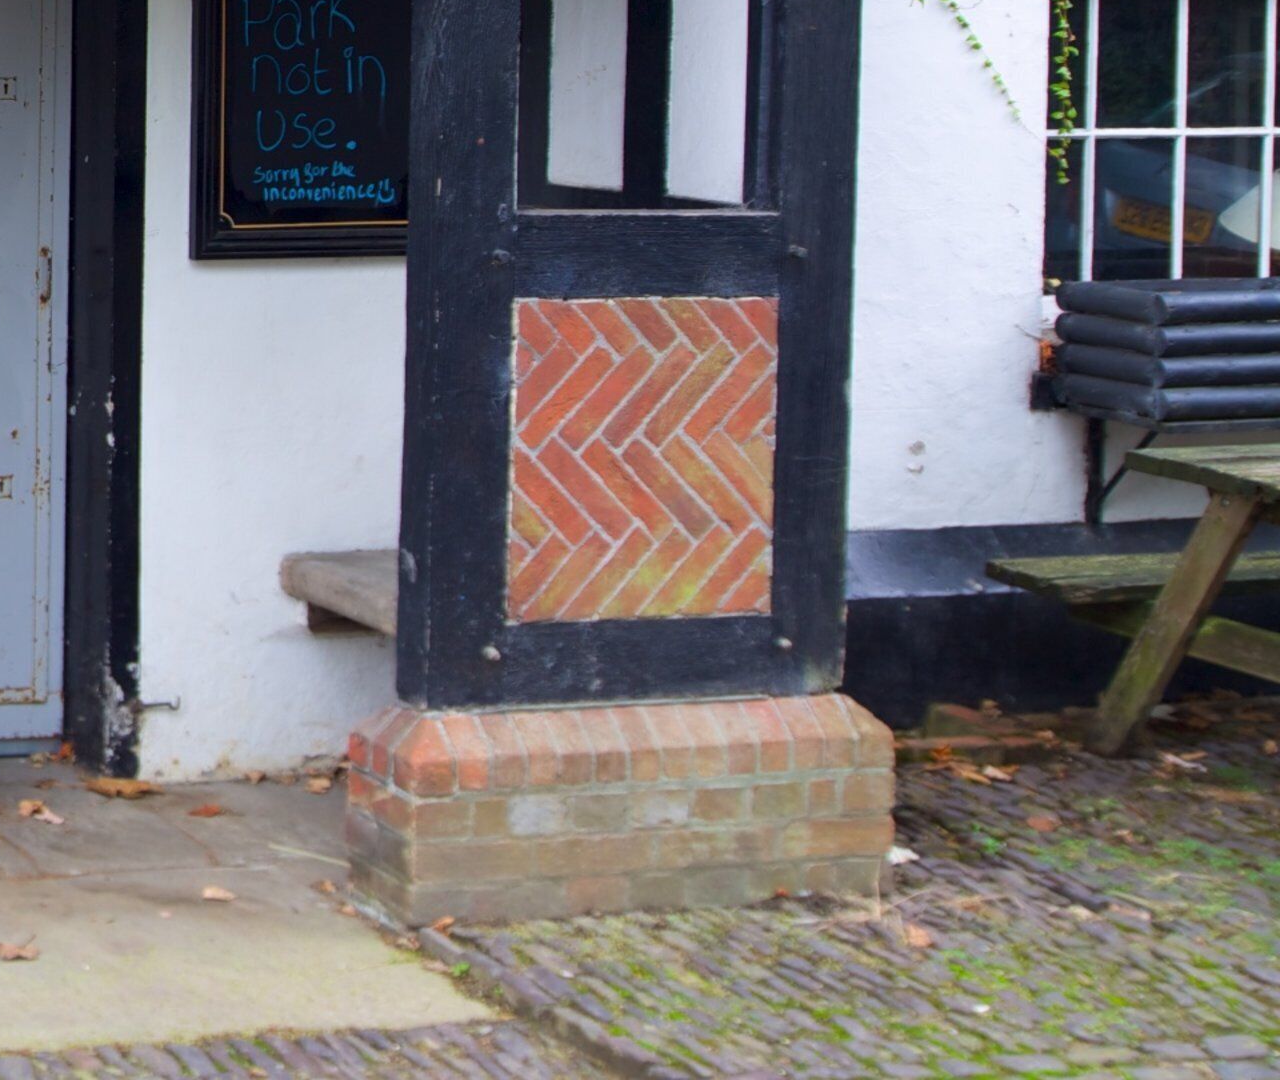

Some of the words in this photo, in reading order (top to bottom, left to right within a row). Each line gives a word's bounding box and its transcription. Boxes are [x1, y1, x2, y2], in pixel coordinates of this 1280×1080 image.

[252, 48, 333, 96] not
[343, 46, 386, 100] in
[253, 166, 300, 187] Sorry
[303, 162, 329, 184] for
[331, 160, 357, 178] the
